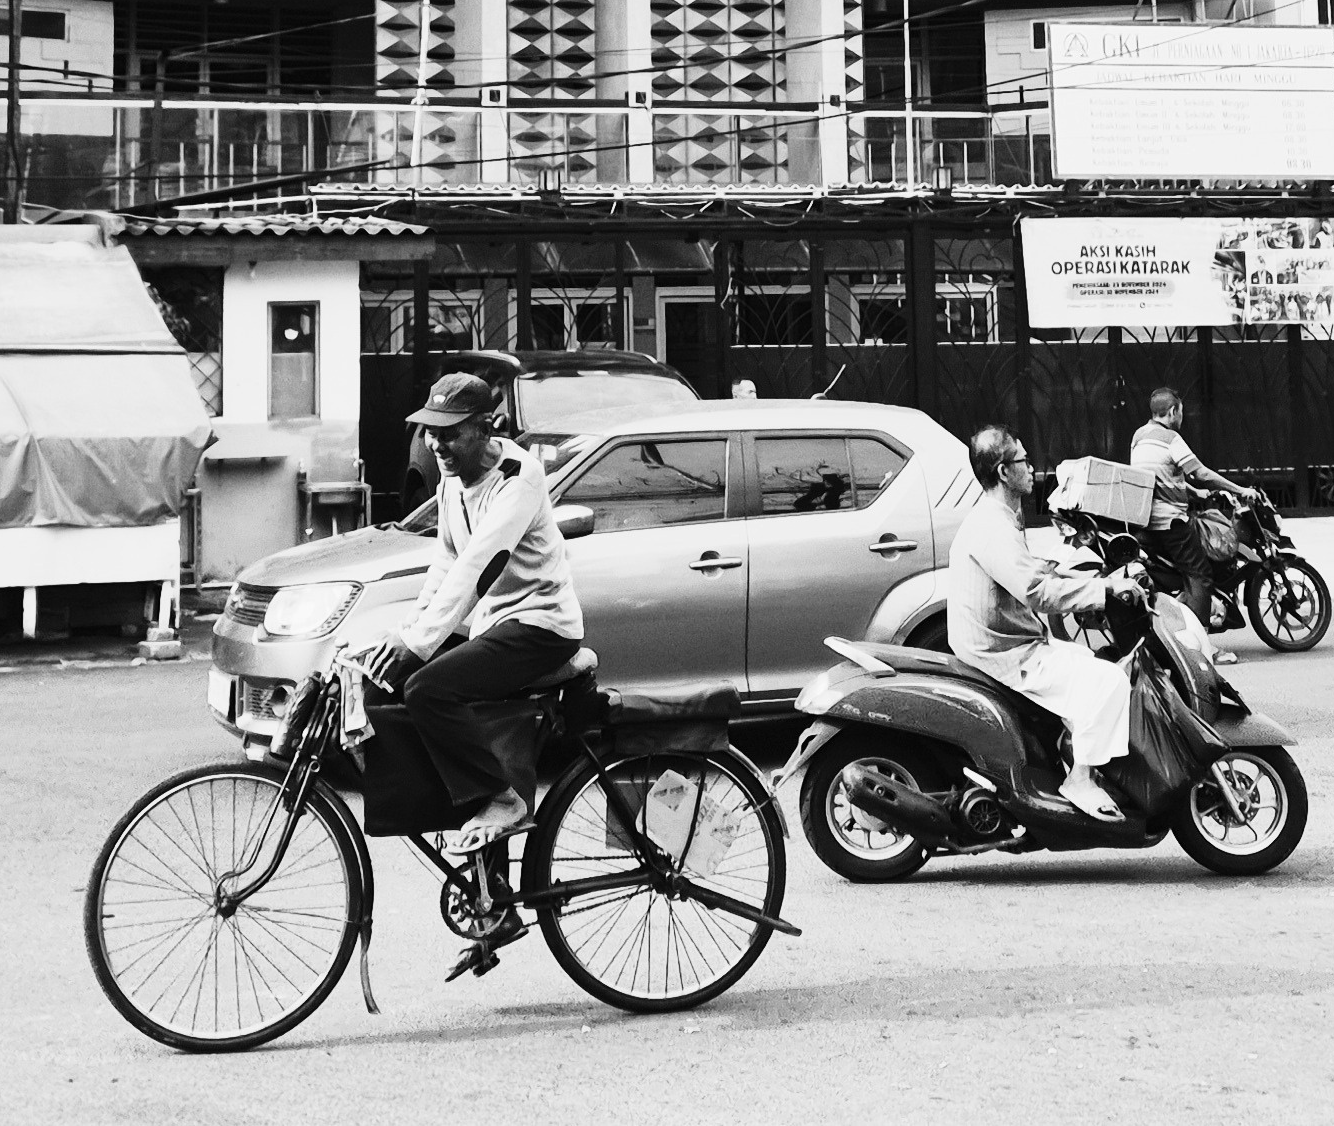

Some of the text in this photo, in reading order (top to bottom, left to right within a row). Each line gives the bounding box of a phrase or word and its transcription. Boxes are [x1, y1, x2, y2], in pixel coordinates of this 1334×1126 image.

[1102, 33, 1140, 58] GKI
[1256, 43, 1294, 61] JAKARTA
[1143, 72, 1207, 84] KEBAKTIAN
[1215, 72, 1242, 84] HARI
[1253, 73, 1297, 85] MINGGU
[1079, 244, 1157, 258] AKSI KASIH
[1050, 260, 1191, 275] OPERASI KATARAK
